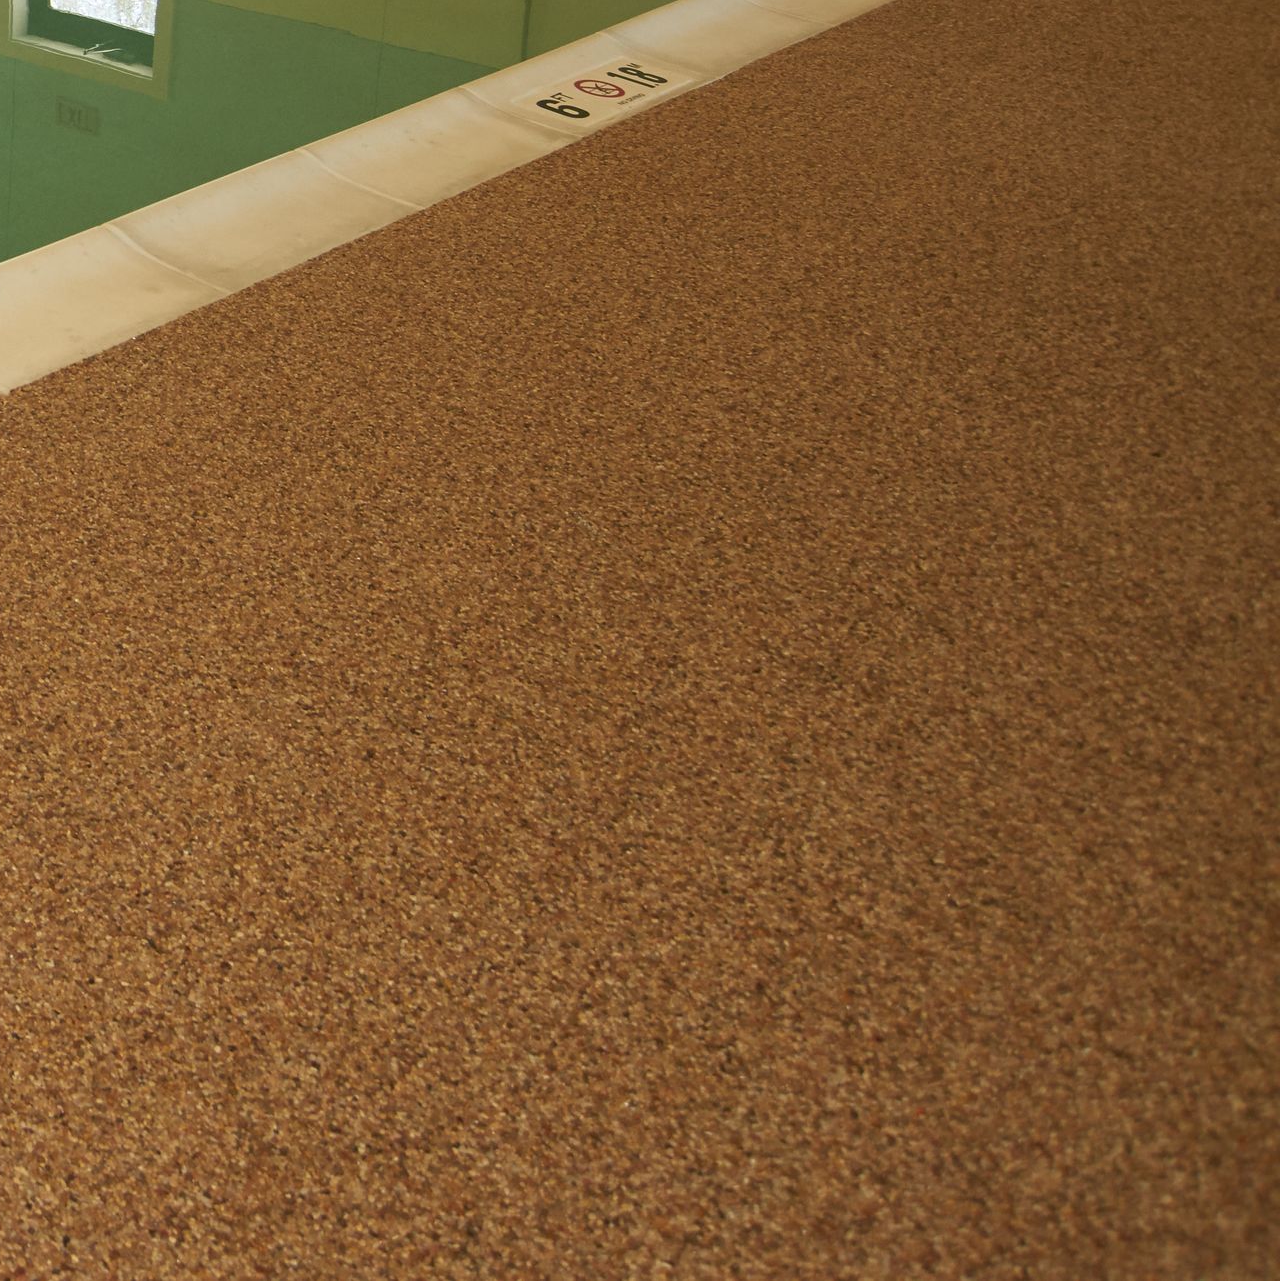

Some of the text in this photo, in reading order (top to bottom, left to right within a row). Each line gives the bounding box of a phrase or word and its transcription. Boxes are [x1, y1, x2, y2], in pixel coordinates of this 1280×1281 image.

[607, 66, 668, 88] 1.8
[550, 92, 574, 103] FT
[536, 99, 590, 119] 6
